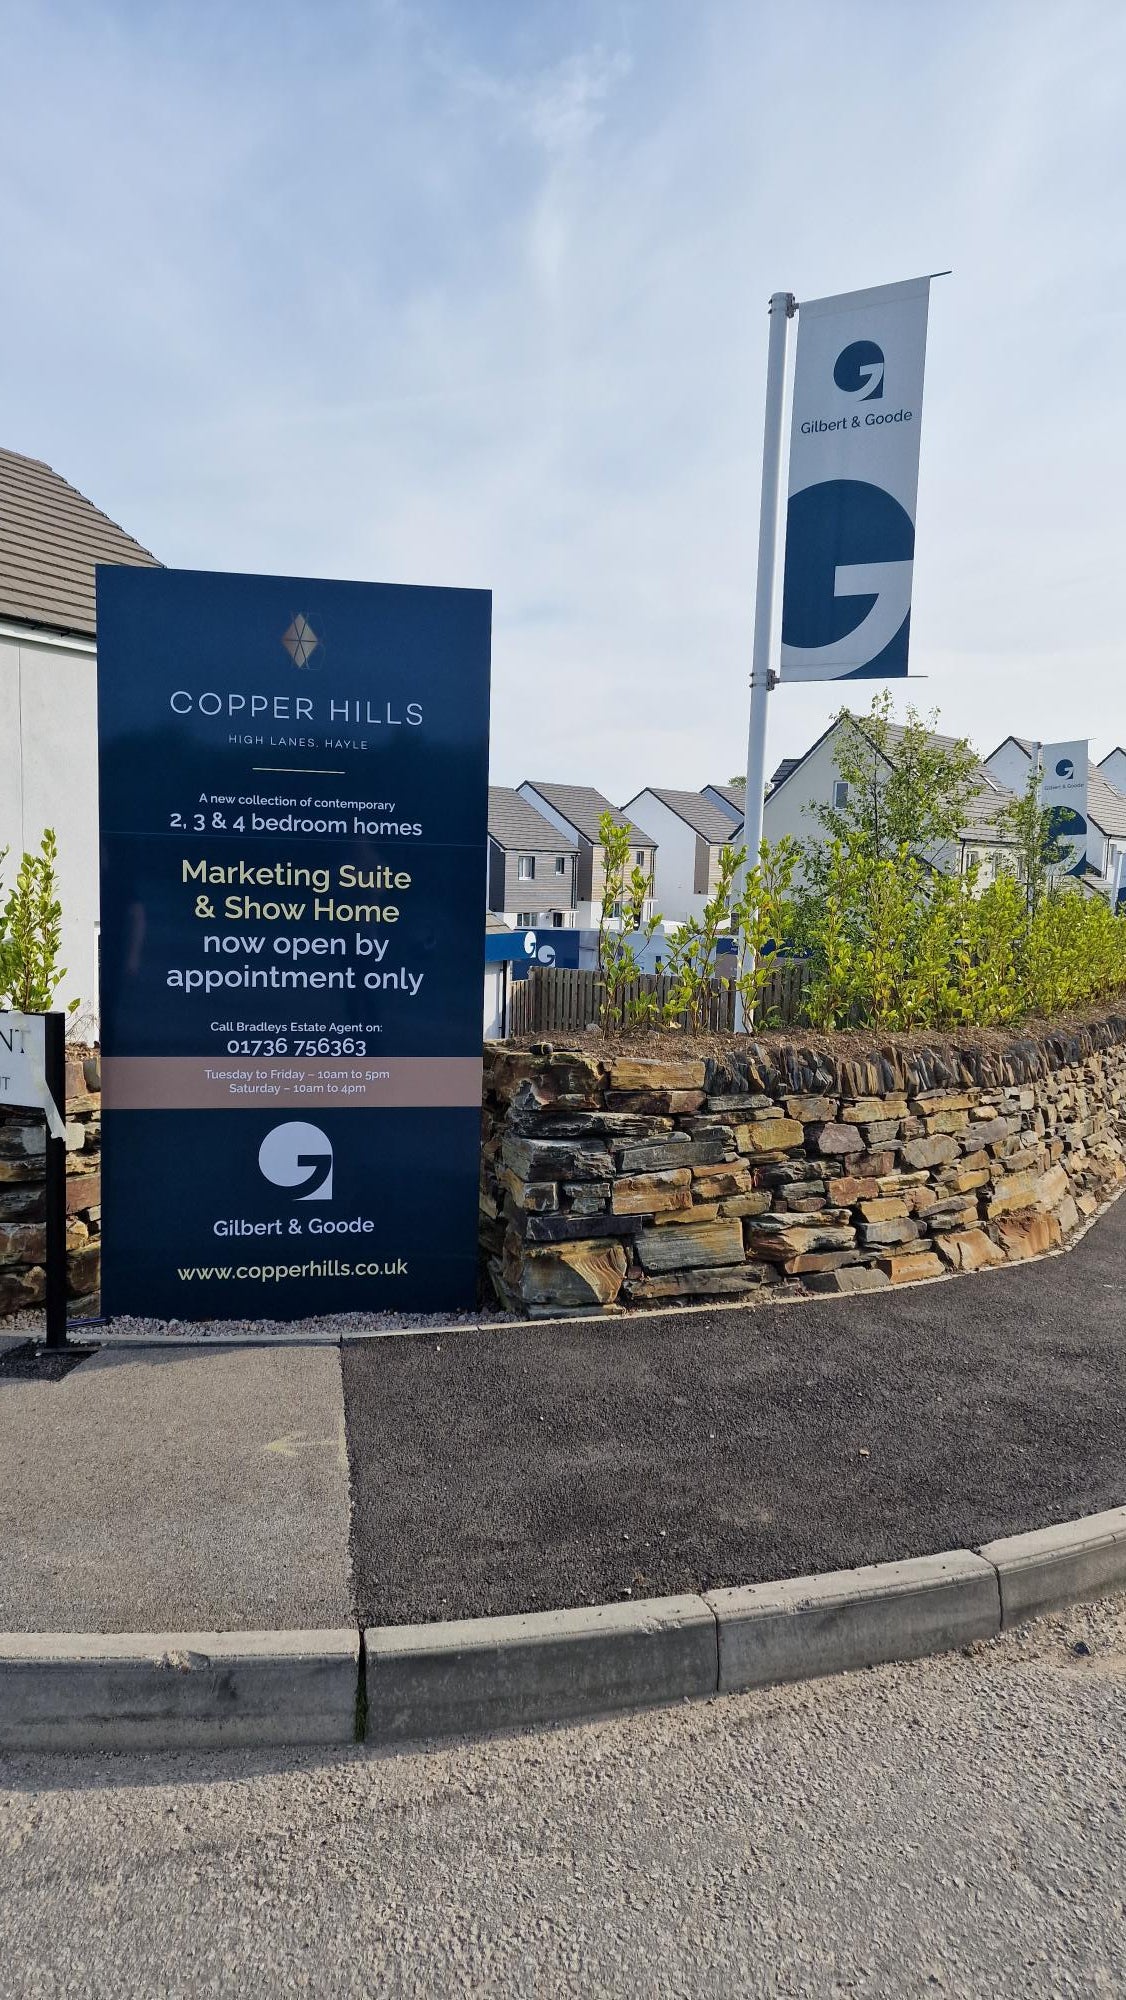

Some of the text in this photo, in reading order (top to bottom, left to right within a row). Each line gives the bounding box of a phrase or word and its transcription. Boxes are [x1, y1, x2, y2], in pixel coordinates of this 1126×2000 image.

[801, 409, 913, 434] Gilbert & Goode
[170, 691, 422, 725] COPPER HILLS
[228, 734, 264, 745] HIGH
[325, 739, 368, 750] HAYLE
[198, 792, 396, 813] A new collection of contemporary
[170, 811, 423, 836] 2, 3 & 4 bedroom homes
[183, 860, 412, 893] Marketing Suite
[194, 894, 400, 923] & Show Home
[203, 933, 389, 962] now open by
[167, 965, 424, 995] appointment only
[210, 1021, 383, 1035] Call Bradleys Estate Agent on:
[226, 1037, 367, 1057] 01736 756363
[204, 1069, 254, 1082] Tuesday
[255, 1069, 268, 1080] to
[270, 1068, 306, 1082] Friday
[317, 1070, 348, 1079] 10am
[350, 1069, 363, 1079] to
[364, 1070, 390, 1081] 5pm
[229, 1083, 281, 1096] Saturday
[293, 1084, 324, 1093] 10am
[326, 1083, 339, 1093] to
[340, 1084, 366, 1095] 4pm
[213, 1216, 375, 1237] Gilbert & Goode
[177, 1258, 408, 1283] www.copperhills.co.uk
